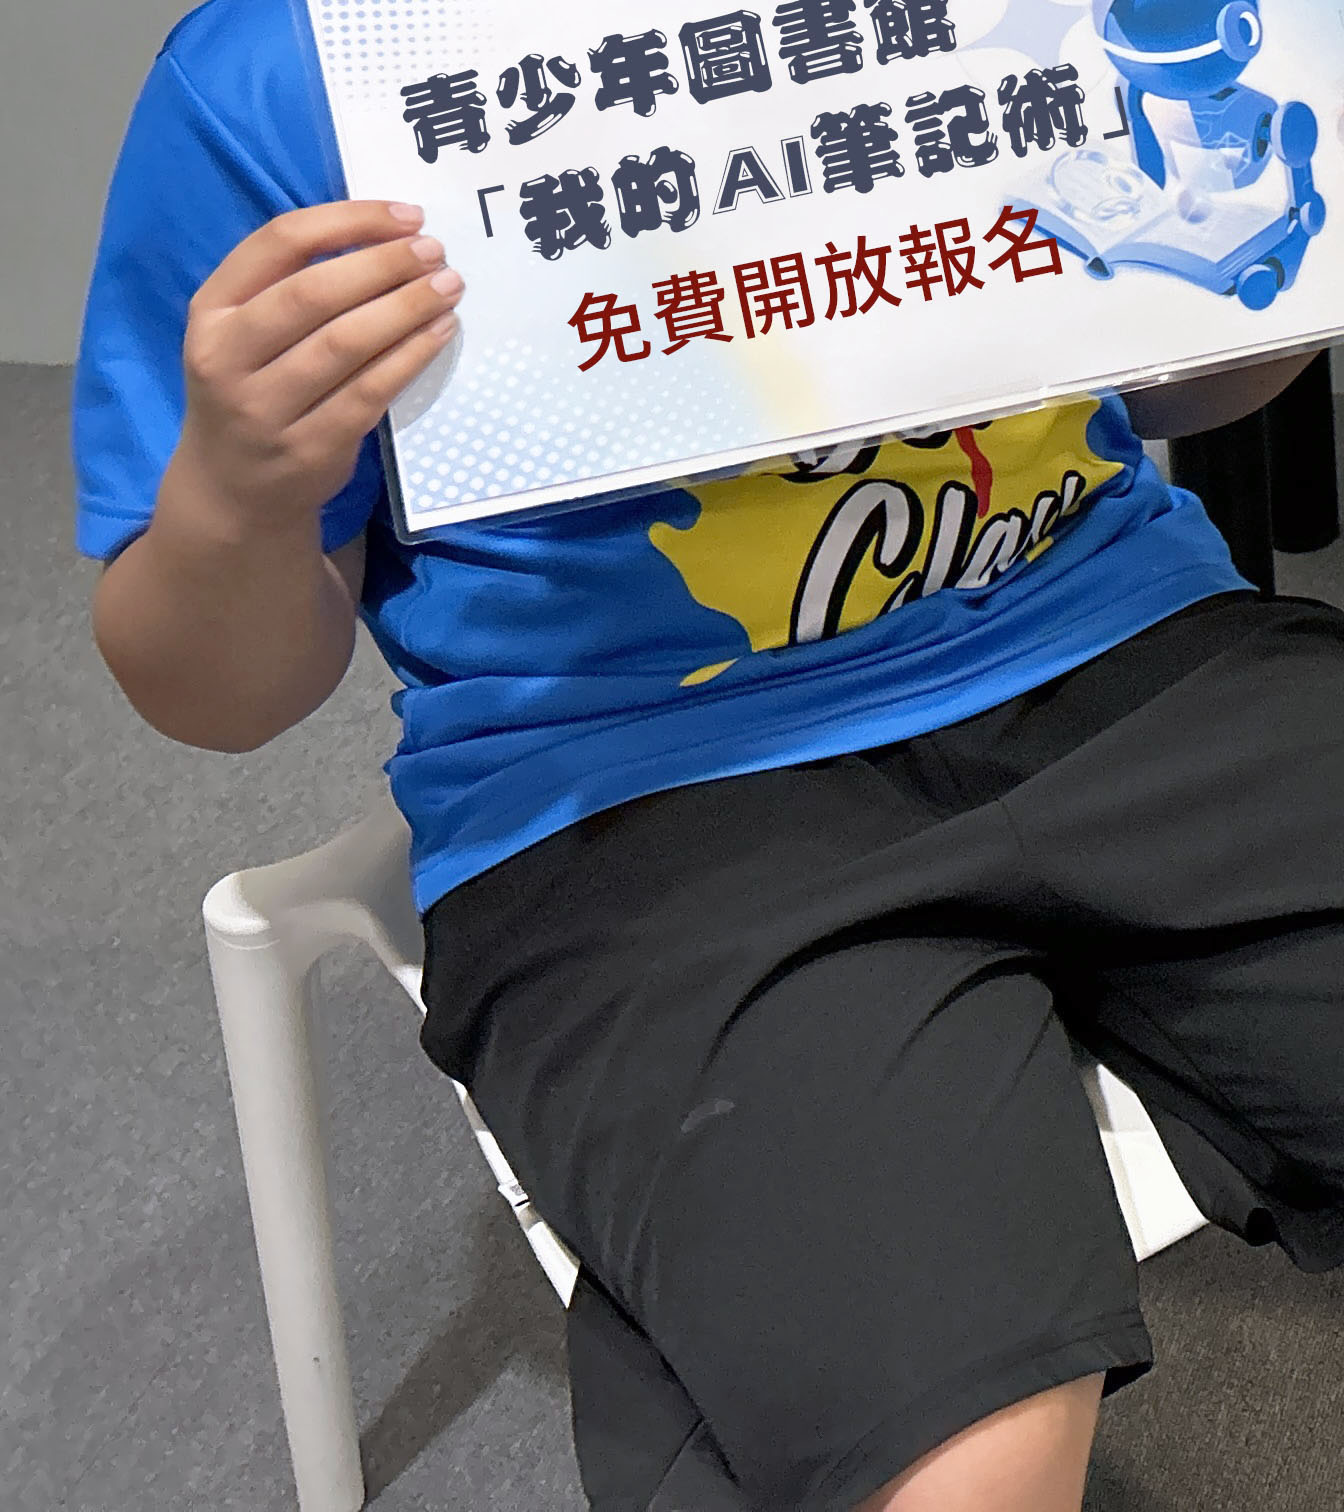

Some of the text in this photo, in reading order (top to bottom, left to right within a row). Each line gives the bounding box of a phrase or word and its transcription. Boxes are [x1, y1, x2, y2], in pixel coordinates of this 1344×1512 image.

[565, 204, 1067, 373] 免費開放報名
